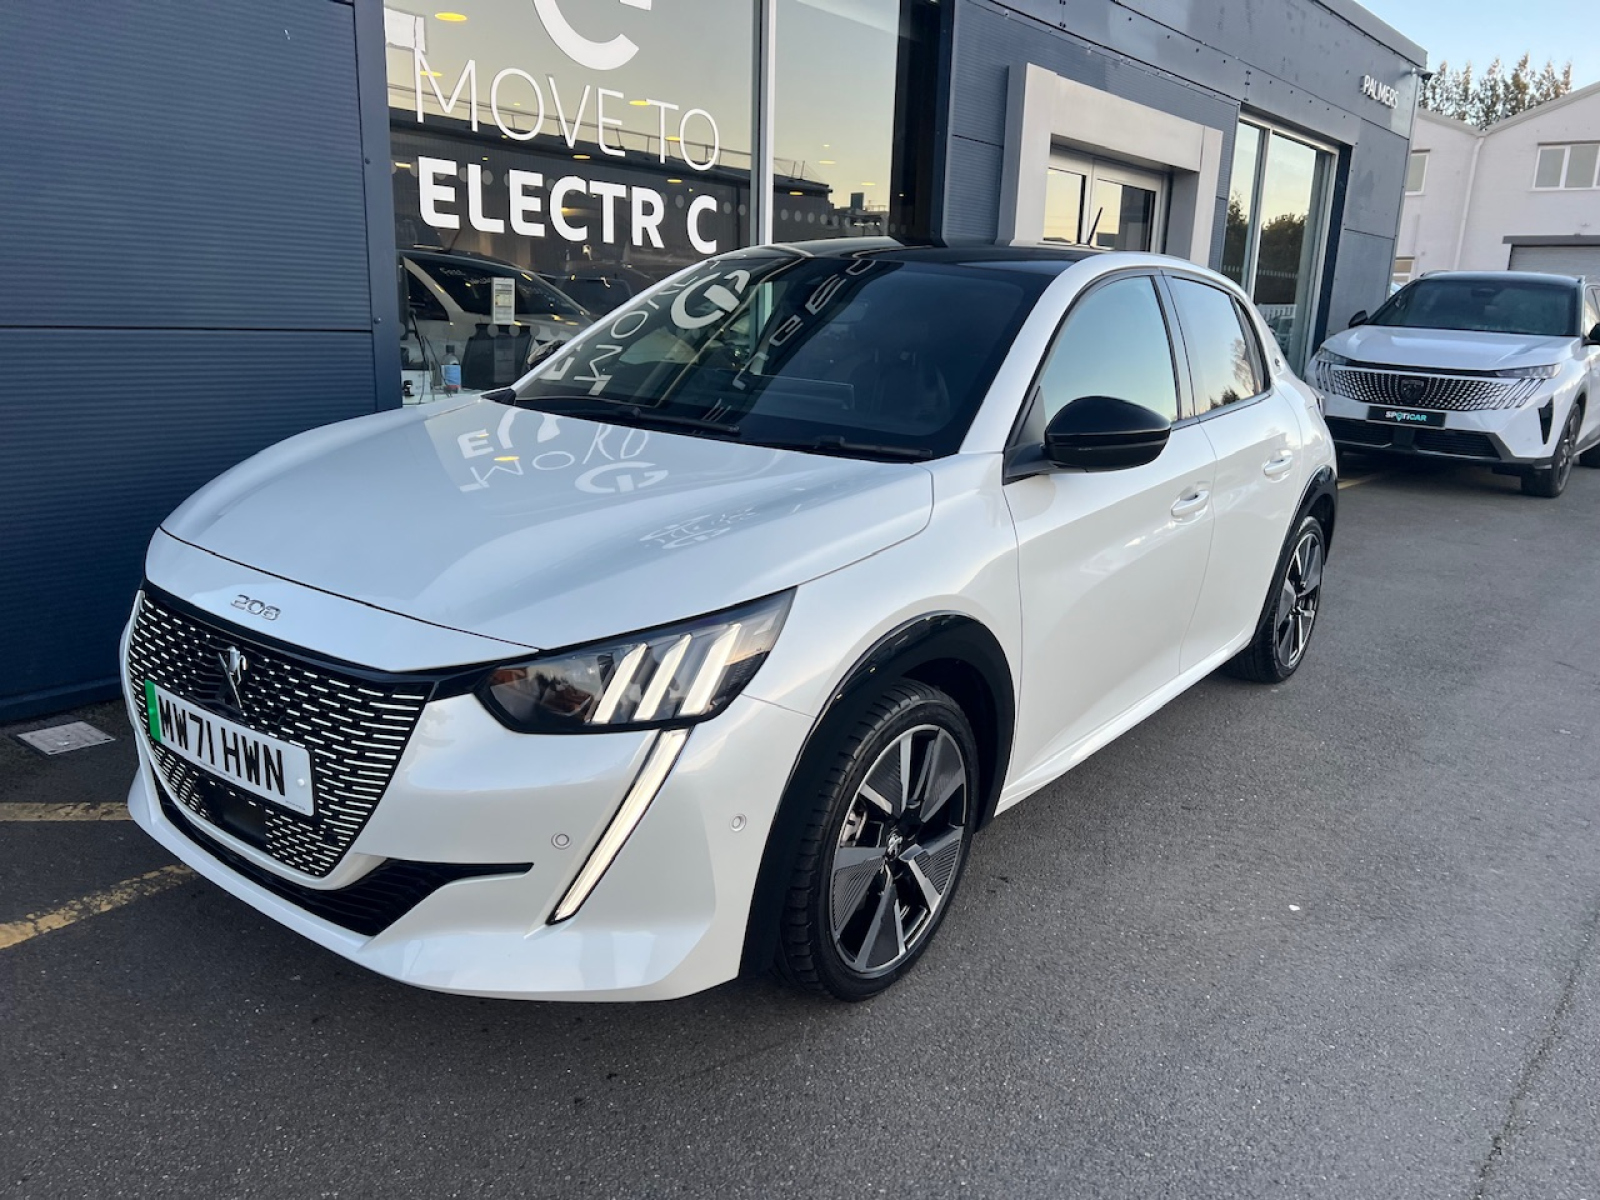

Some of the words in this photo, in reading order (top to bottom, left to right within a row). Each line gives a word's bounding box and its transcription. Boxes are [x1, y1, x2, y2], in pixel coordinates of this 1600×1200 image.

[1363, 74, 1399, 109] PALMERS
[413, 49, 626, 157] MOVE
[646, 99, 720, 171] TO
[1385, 410, 1427, 421] SPOTICAR
[231, 594, 281, 621] 208
[158, 694, 215, 766] MW71
[221, 726, 286, 797] HWN
